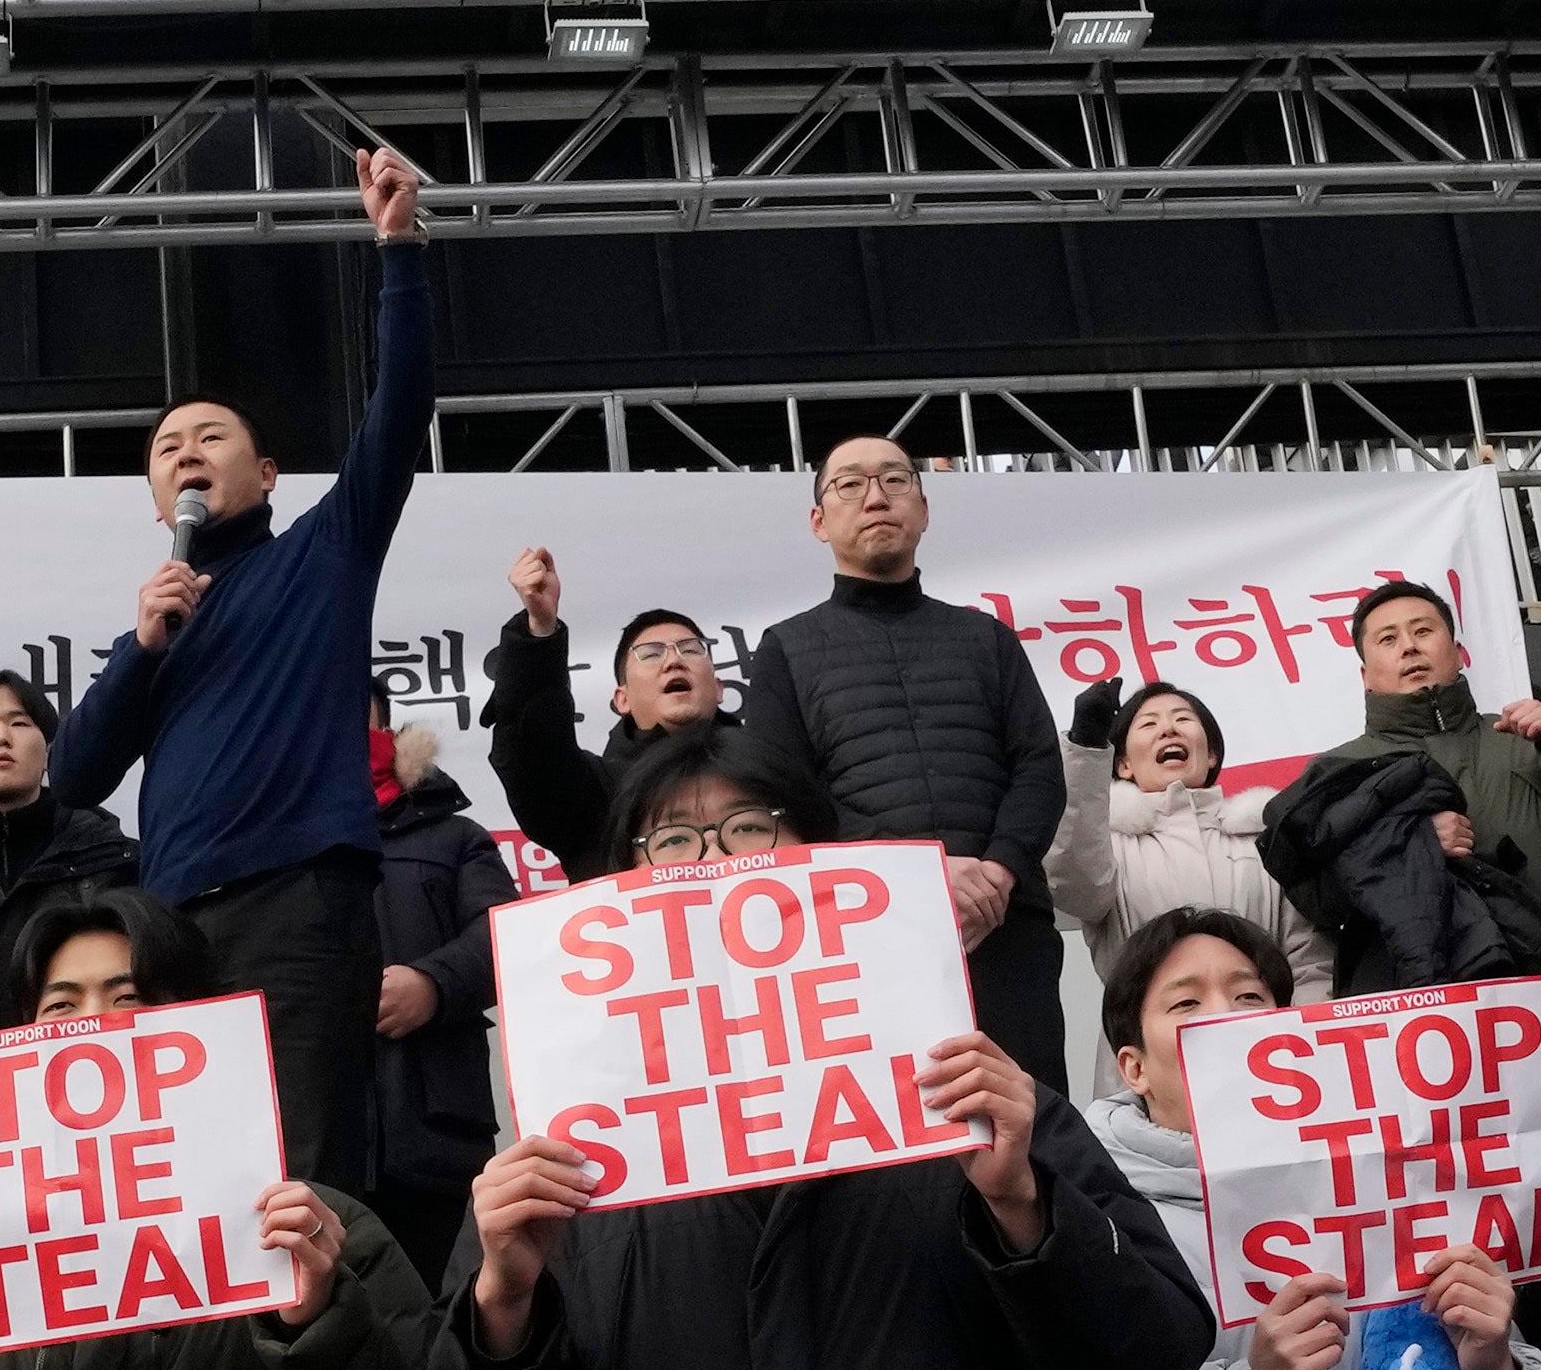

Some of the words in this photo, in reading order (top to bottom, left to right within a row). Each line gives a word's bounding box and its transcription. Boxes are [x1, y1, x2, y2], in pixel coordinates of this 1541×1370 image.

[651, 860, 727, 884] SUPPORT
[728, 852, 777, 878] YOON
[558, 867, 891, 997] STOP
[56, 1017, 102, 1037] YOON
[606, 962, 873, 1087] THE
[1332, 996, 1401, 1019] SUPPORT
[1402, 989, 1447, 1008] YOON
[546, 1053, 972, 1199] STEAL
[1298, 1099, 1523, 1208] THE
